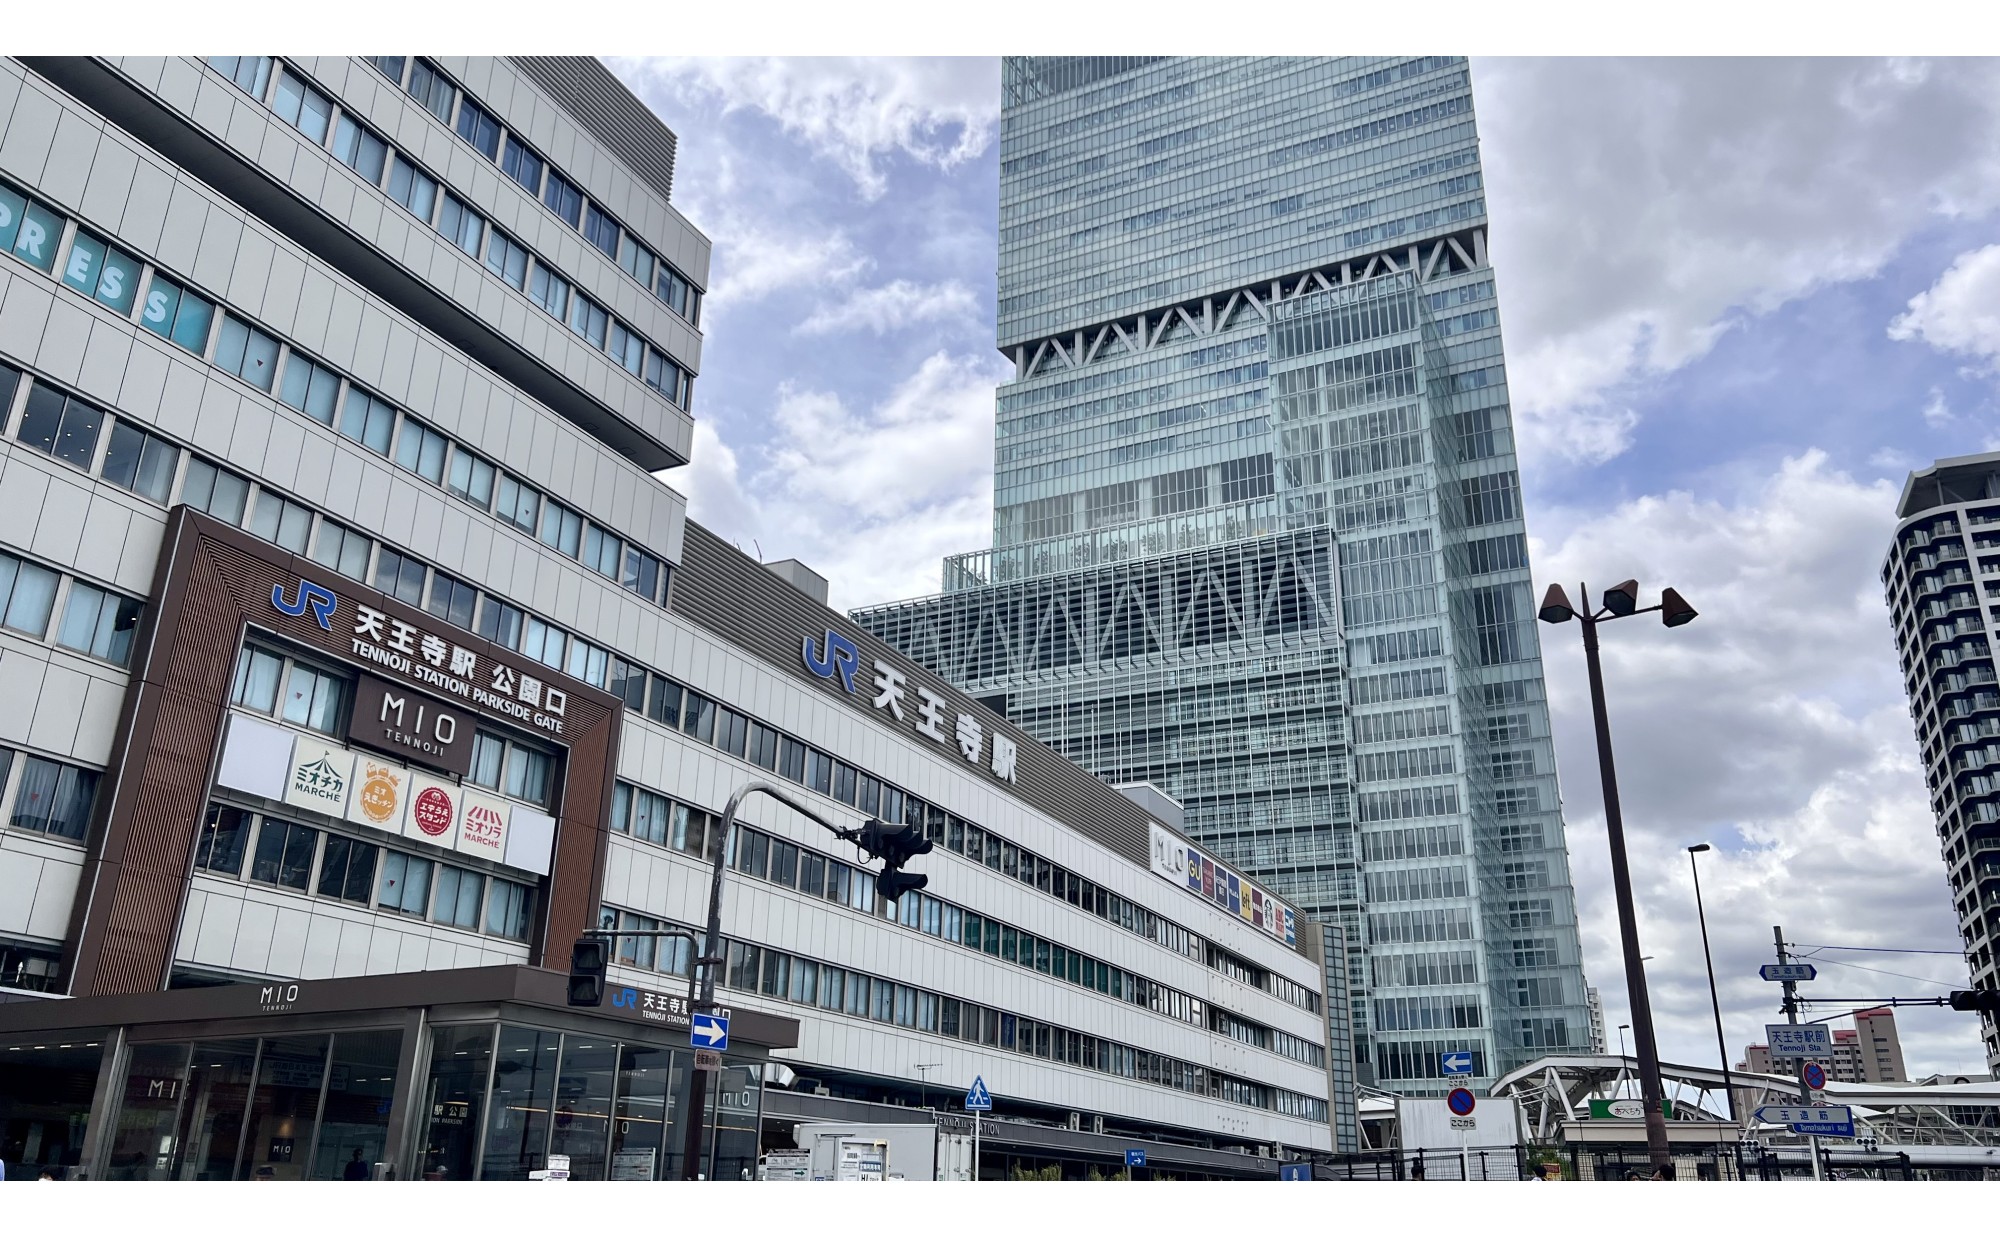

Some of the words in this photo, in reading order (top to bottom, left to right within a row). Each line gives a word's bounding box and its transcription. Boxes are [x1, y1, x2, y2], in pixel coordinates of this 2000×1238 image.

[271, 579, 338, 632] JR
[354, 603, 477, 681] 天王寺駅
[491, 663, 567, 717] 公園口
[803, 628, 860, 695] JR
[414, 664, 470, 698] STATION
[472, 687, 531, 722] PARKSIDE
[533, 712, 564, 734] GATE
[380, 692, 456, 745] MIO
[872, 659, 1018, 786] 天王寺駅
[386, 728, 444, 757] TENNOJI
[297, 766, 344, 793] ミオチカ
[465, 818, 502, 839] ミオソラ
[1154, 831, 1184, 872] MIO
[1188, 859, 1201, 881] GU
[260, 985, 298, 1004] MIO
[612, 988, 638, 1010] JR
[667, 1014, 690, 1026] STATION
[1771, 1030, 1826, 1043] 天王寺駅前
[1778, 1044, 1806, 1052] Tennoji
[722, 1091, 750, 1107] MIO
[1450, 1119, 1476, 1127] ここから
[1780, 1110, 1829, 1121] 玉造筋
[969, 1121, 1000, 1135] SATION
[272, 1144, 291, 1154] MIO
